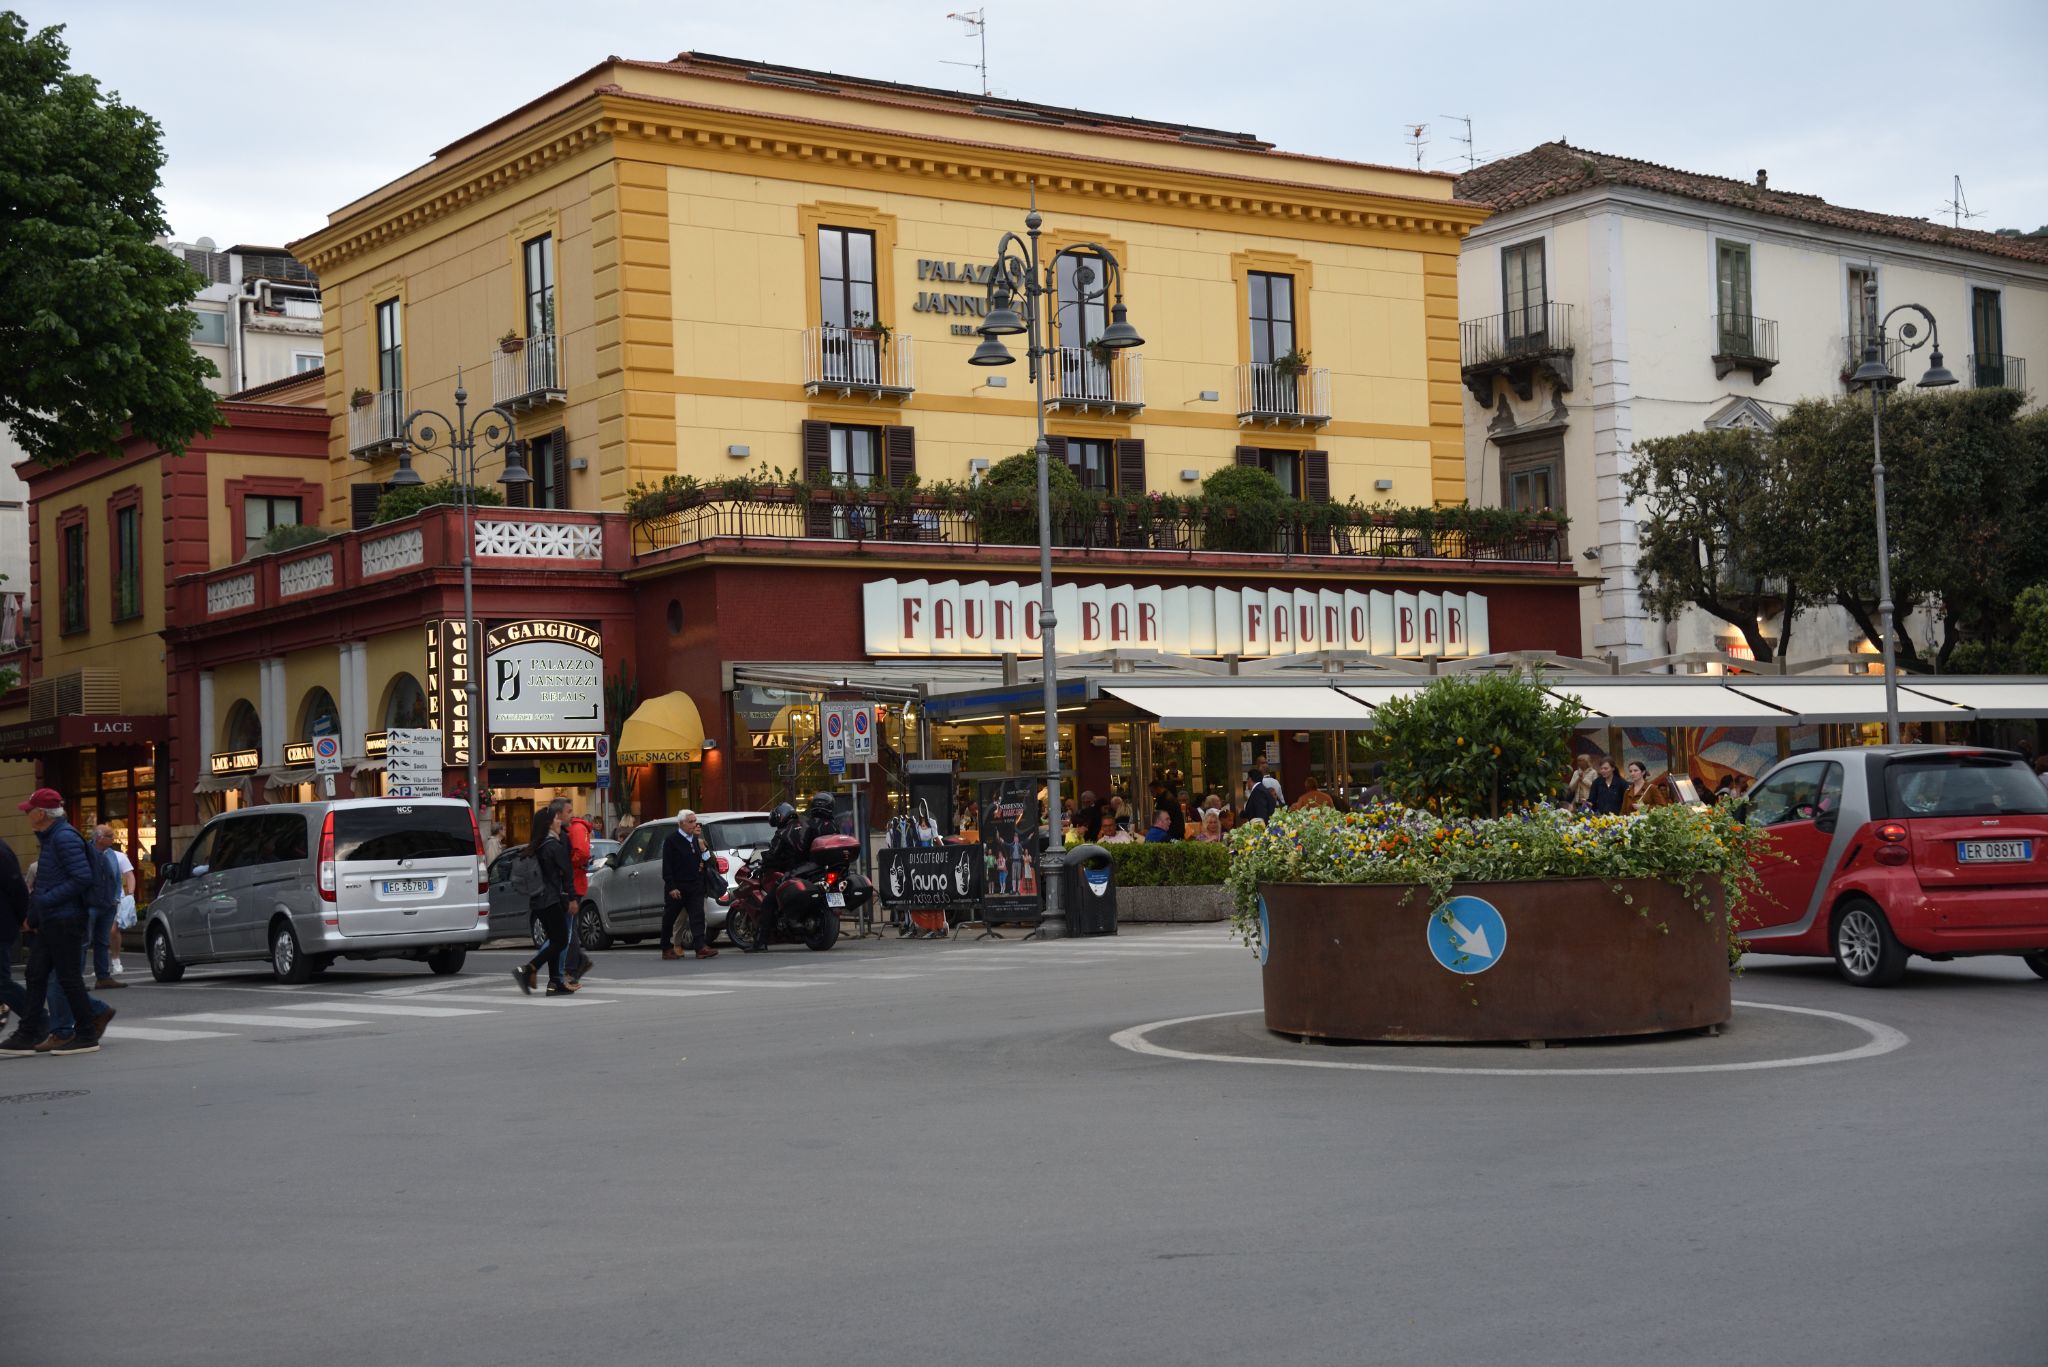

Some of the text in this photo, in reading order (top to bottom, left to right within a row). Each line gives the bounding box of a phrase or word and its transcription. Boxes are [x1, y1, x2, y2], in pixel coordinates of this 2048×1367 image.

[903, 598, 1157, 641] FAUNO BAR
[1248, 605, 1462, 644] FAUNO BAR
[488, 623, 599, 649] A. GARGIULO
[531, 659, 594, 671] PALAZZO
[527, 674, 599, 687] JANNUZZI
[541, 691, 586, 702] RELAIS
[93, 722, 133, 733] LACE
[502, 736, 595, 752] JANNUZZI
[211, 753, 258, 771] LACE LINENS
[645, 751, 690, 762] SNACKS
[557, 762, 593, 774] ATM
[396, 806, 413, 815] NCC
[1967, 843, 2023, 858] ER 088XT
[909, 852, 949, 864] DISCOTEQUE
[389, 882, 400, 892] EG
